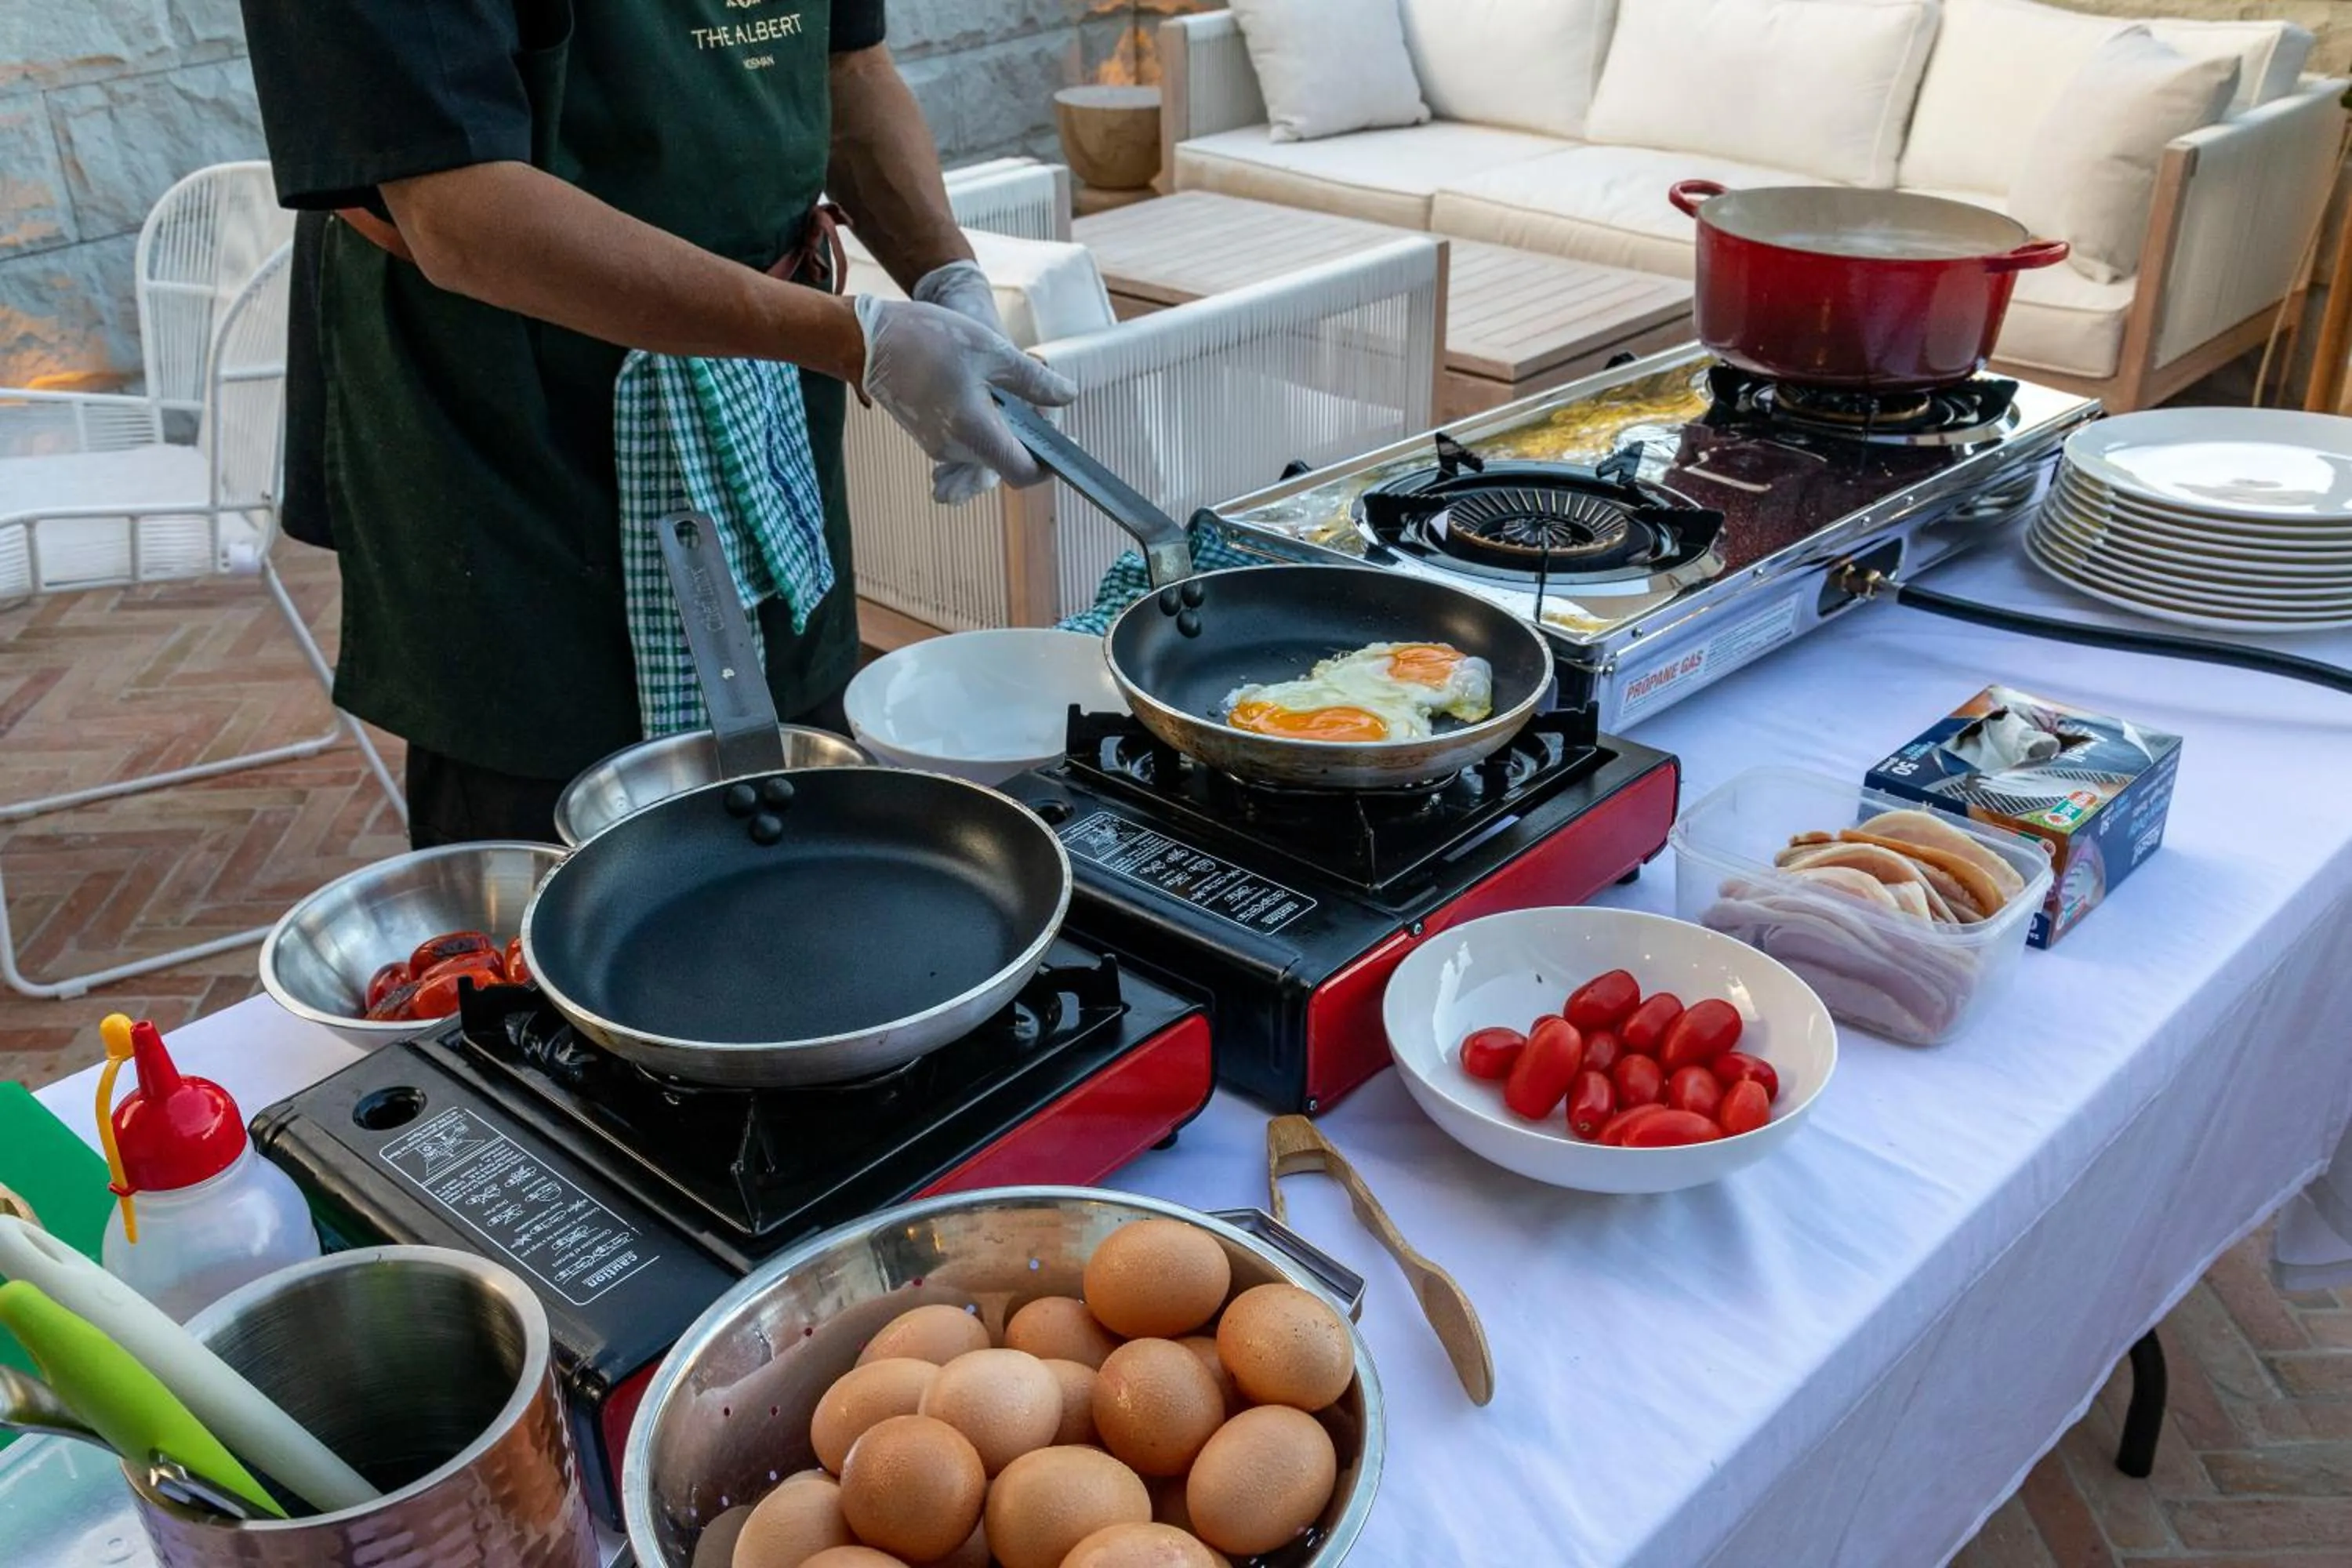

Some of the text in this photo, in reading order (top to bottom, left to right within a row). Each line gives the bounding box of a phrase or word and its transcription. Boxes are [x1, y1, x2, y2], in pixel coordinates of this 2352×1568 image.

[691, 13, 802, 50] THE ALBERT
[1626, 663, 1679, 702] PROPANE
[1680, 651, 1704, 673] GAS
